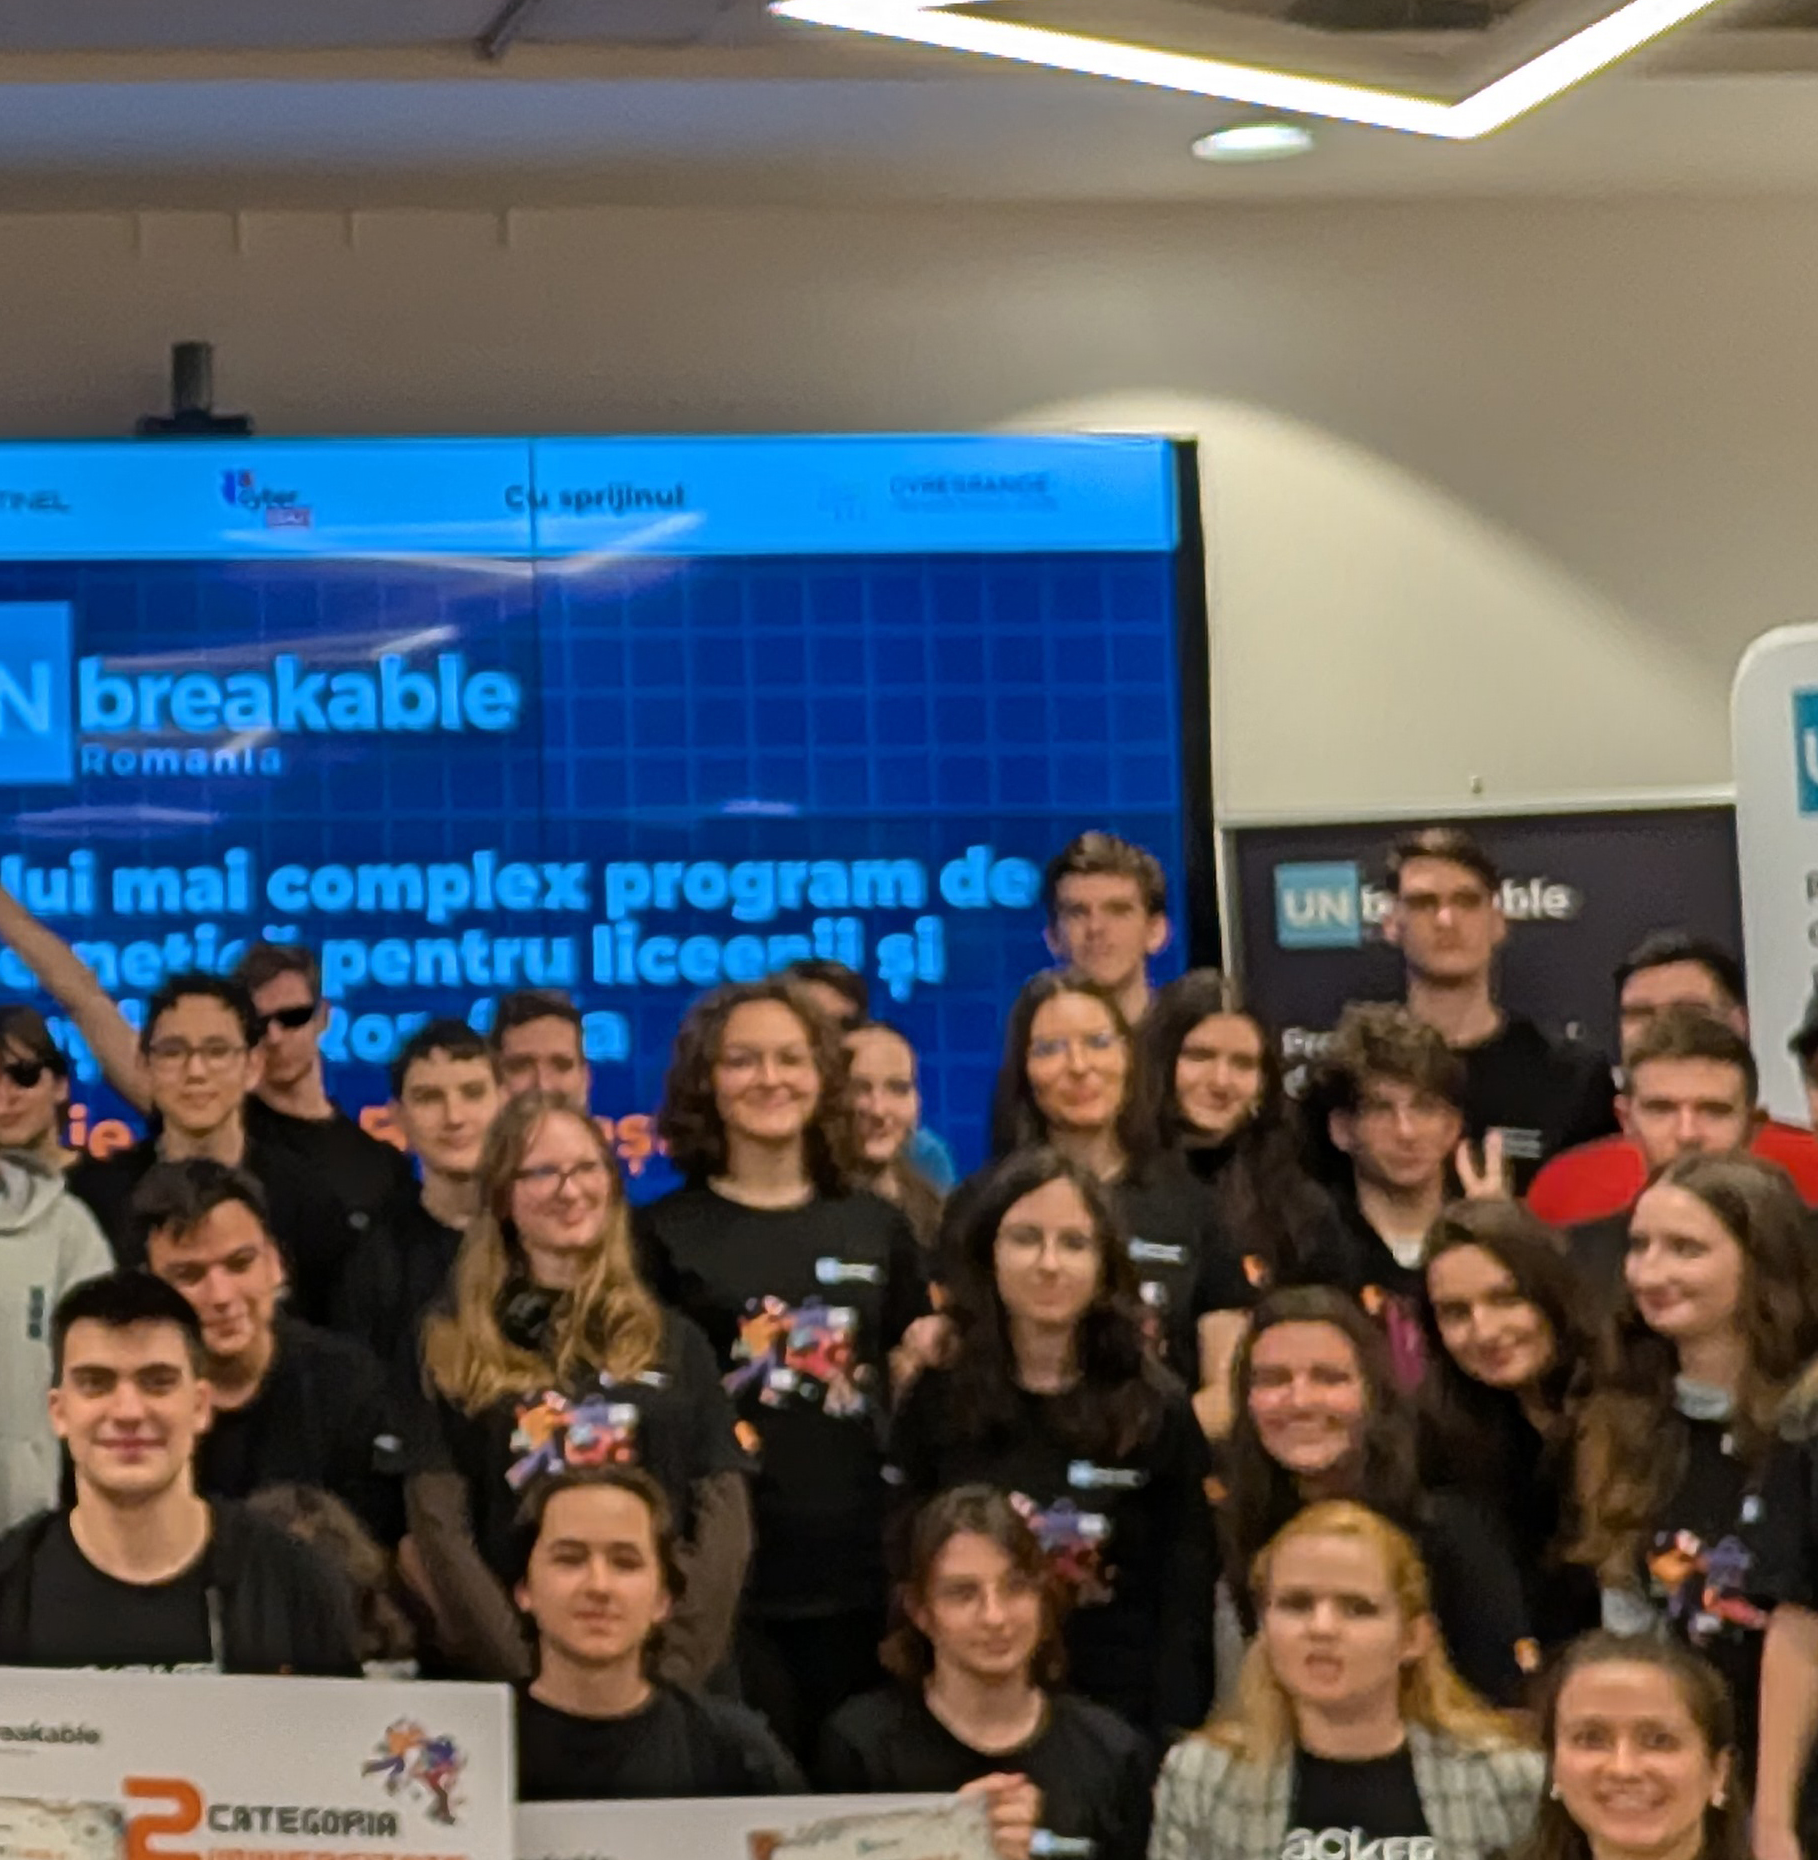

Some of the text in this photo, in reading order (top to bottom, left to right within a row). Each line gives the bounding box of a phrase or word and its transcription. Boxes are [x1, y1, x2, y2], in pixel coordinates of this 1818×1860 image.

[504, 483, 685, 515] Cu sprijinul
[81, 743, 283, 776] Romania
[112, 848, 250, 915] mai
[266, 851, 588, 924] complex
[603, 859, 928, 920] program
[938, 845, 1042, 908] de
[321, 933, 576, 1000] pentru
[876, 916, 945, 1001] și
[207, 1805, 397, 1837] CATEGORIA
